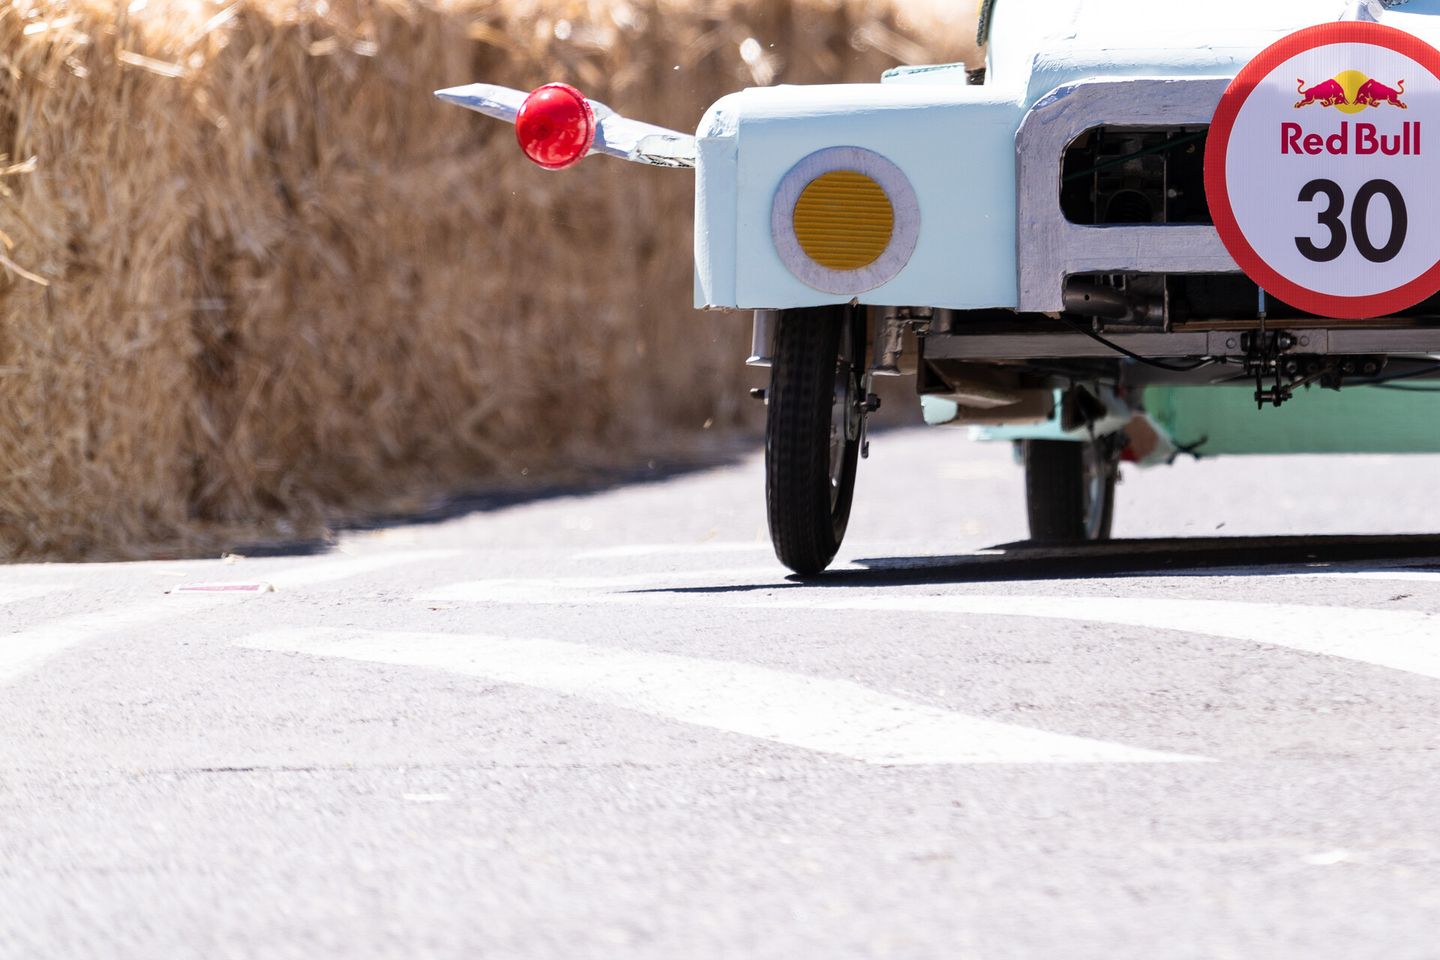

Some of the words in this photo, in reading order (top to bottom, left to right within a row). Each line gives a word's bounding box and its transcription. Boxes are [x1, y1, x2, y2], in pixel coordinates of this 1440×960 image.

[1281, 121, 1348, 155] Red
[1355, 121, 1421, 156] Bull
[1294, 178, 1408, 263] 30
